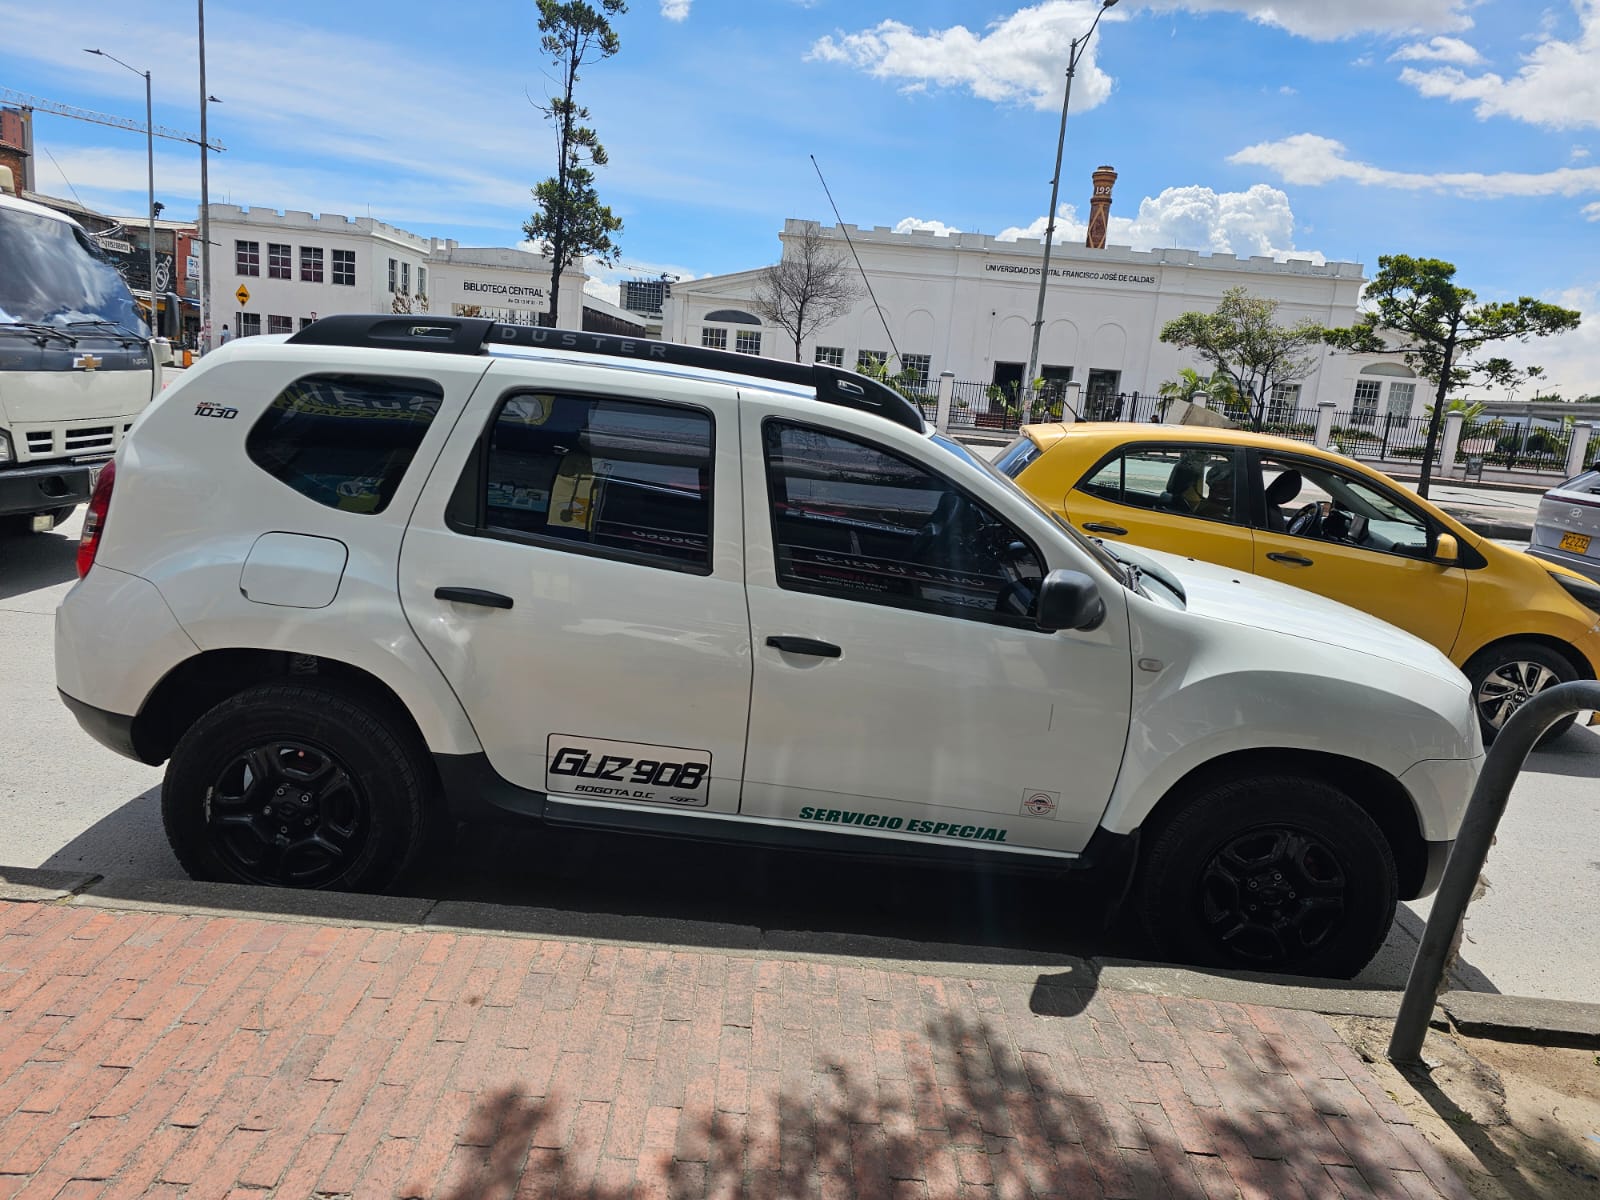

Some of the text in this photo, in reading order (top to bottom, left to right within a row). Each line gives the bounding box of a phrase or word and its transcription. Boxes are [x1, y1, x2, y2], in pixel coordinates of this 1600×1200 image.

[985, 264, 1029, 275] UNIVERSIDAD
[1029, 267, 1061, 277] DISITAL
[1062, 270, 1099, 280] FRANCISCO
[1100, 272, 1117, 281] JOSÉ
[1129, 275, 1155, 284] CALDAS
[463, 282, 544, 298] BIBLIOTECA CENTRAL
[501, 327, 667, 358] DUSTER
[194, 406, 239, 420] 1030
[549, 747, 709, 790] GUZ 908
[574, 784, 630, 797] BOGOTA
[799, 806, 1008, 842] SERVICIO ESPECIAL
